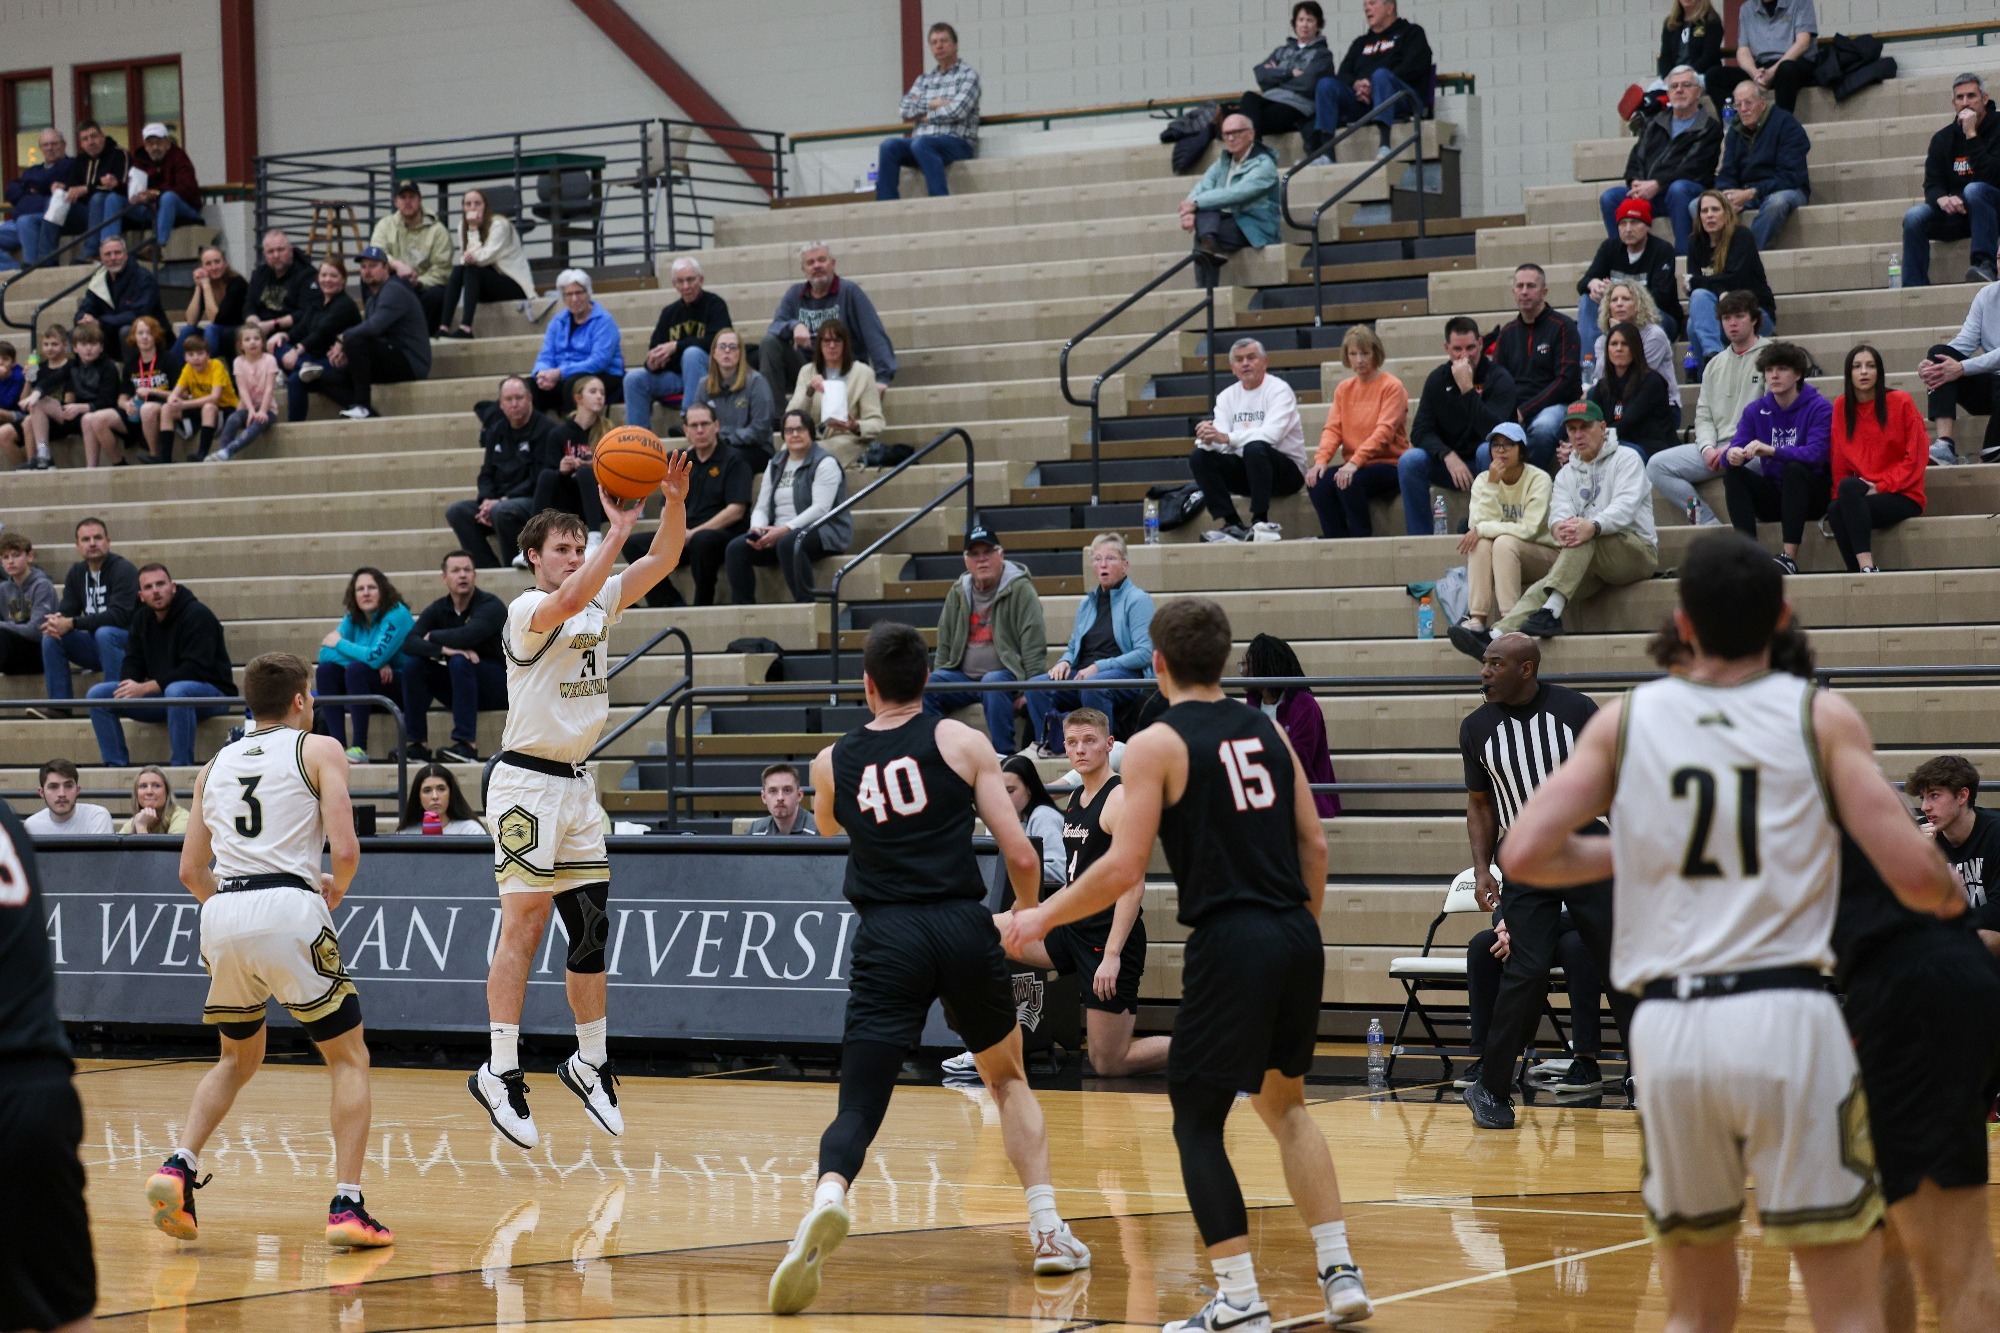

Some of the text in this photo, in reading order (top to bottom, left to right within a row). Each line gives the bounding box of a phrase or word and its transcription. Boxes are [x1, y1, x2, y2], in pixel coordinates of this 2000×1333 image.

[367, 622, 396, 662] ARIAT
[235, 775, 263, 838] 3
[856, 755, 928, 824] 40
[1218, 737, 1277, 812] 15
[1670, 763, 1762, 878] 21
[98, 903, 463, 972] WEAN
[486, 907, 856, 981] NIVERSI
